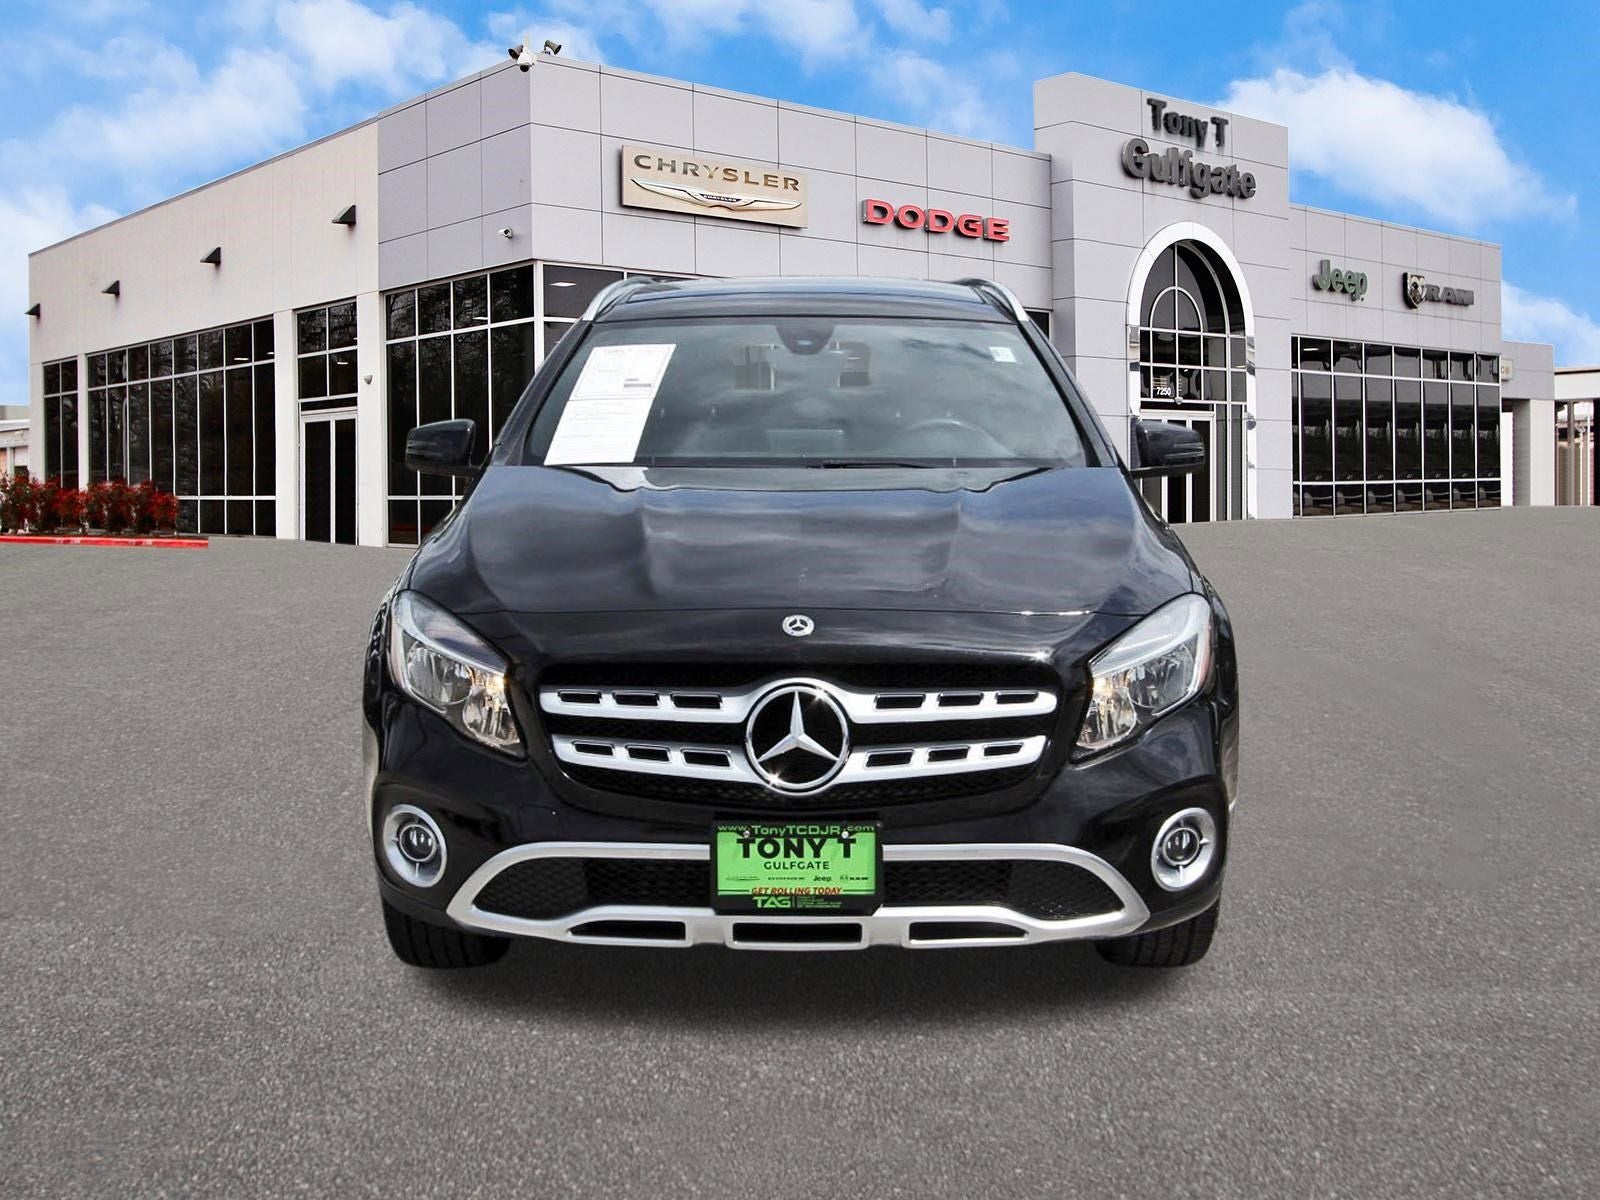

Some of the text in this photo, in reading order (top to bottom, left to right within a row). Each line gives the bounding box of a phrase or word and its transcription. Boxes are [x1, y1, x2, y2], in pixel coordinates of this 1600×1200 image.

[1146, 98, 1229, 147] Tony T
[634, 154, 800, 192] CHRYSLER
[1122, 137, 1257, 199] Gulfgate
[862, 198, 1011, 243] DODGE
[1313, 259, 1367, 302] Jeep
[1425, 283, 1475, 306] RAM
[1156, 387, 1171, 396] 7250
[736, 837, 857, 859] TONY T
[763, 861, 830, 870] GULFGATE
[752, 887, 843, 895] GET ROLLING TODAY
[752, 896, 792, 908] TAG
